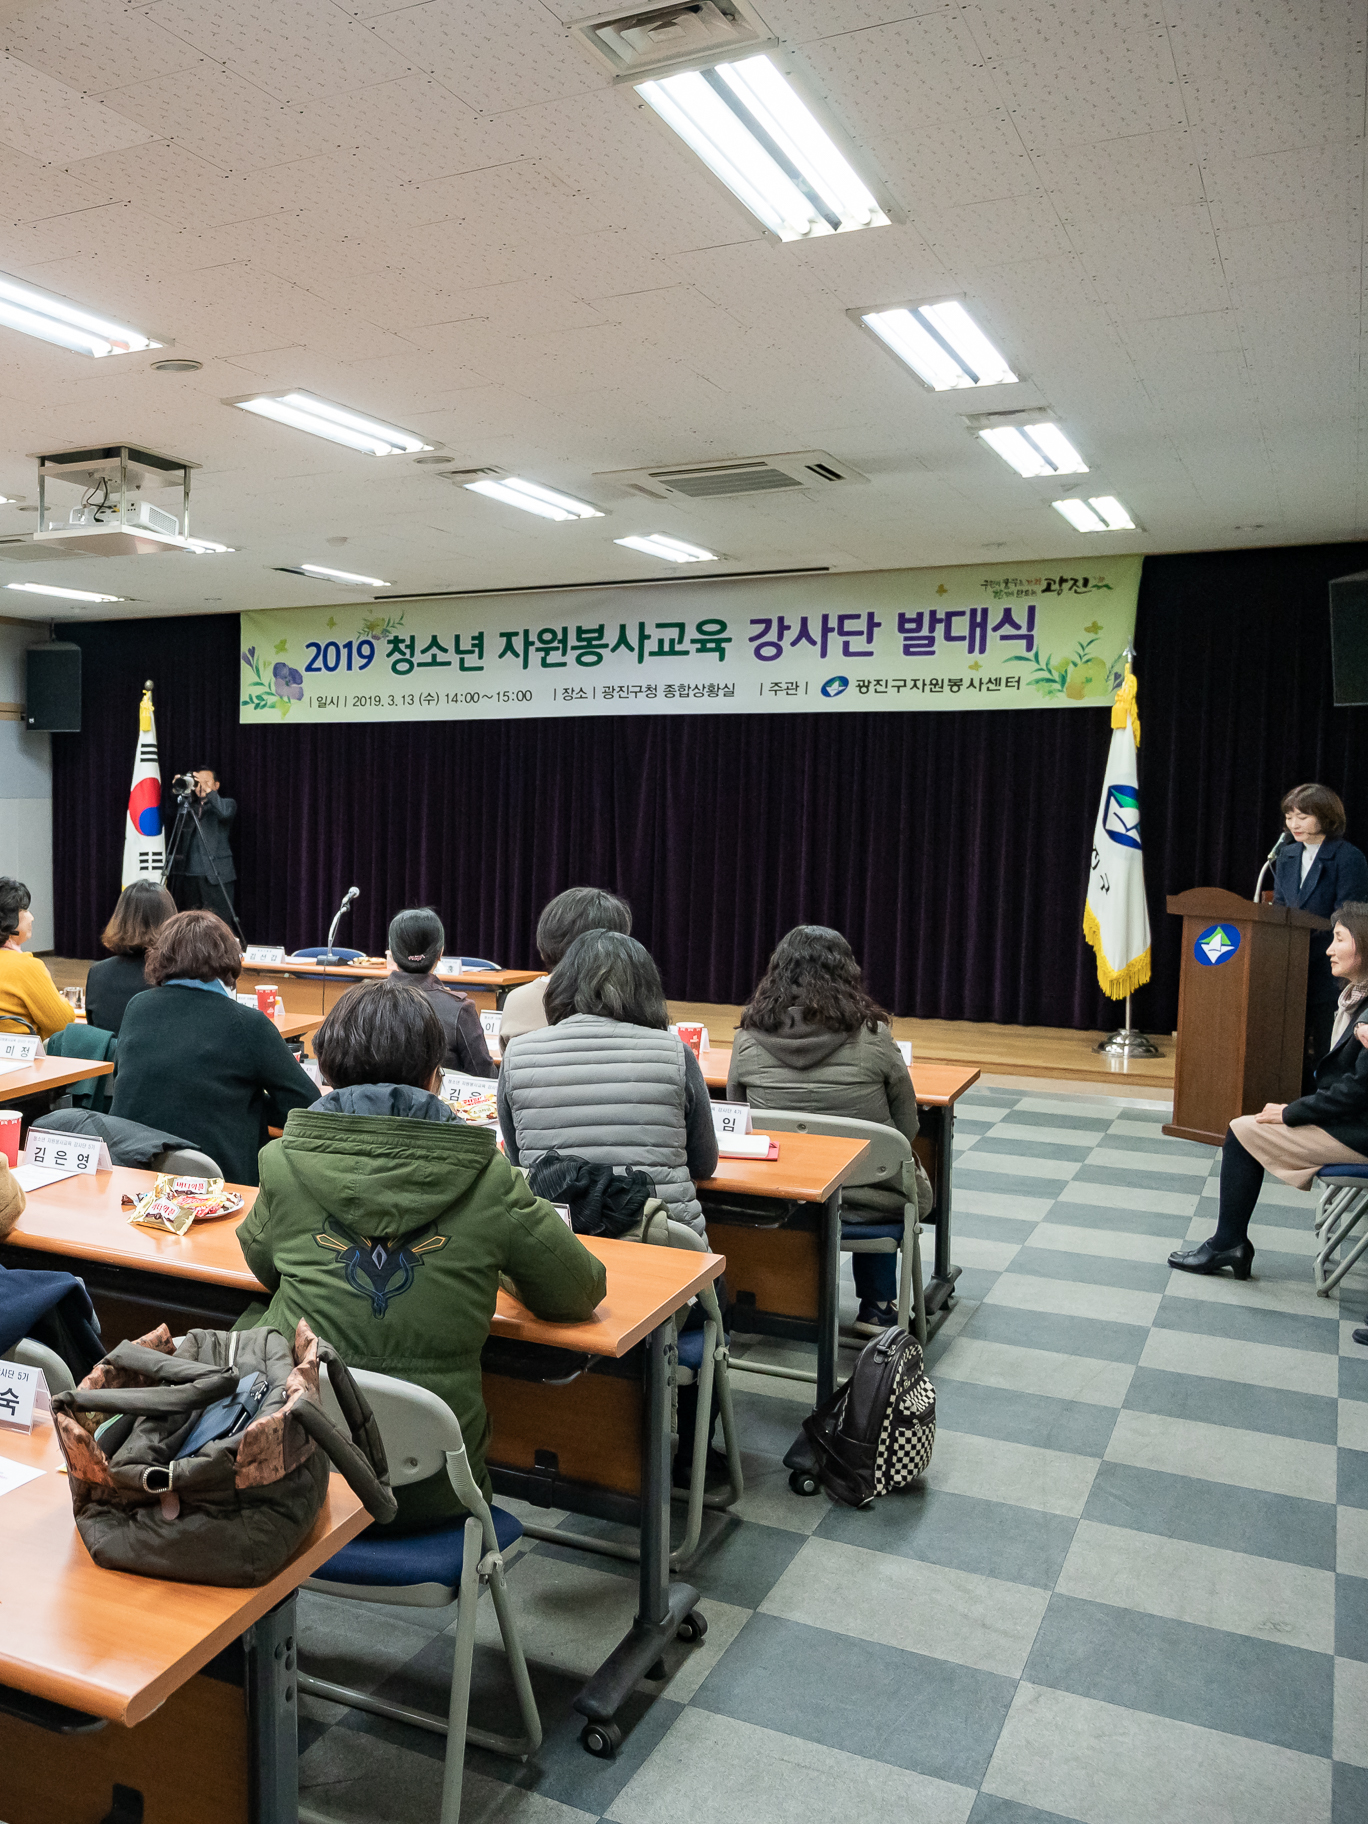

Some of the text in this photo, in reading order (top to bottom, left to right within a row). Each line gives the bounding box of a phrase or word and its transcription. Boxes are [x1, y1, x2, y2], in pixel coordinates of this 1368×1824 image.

[1041, 575, 1092, 596] 광진
[304, 604, 1037, 676] 2019 청소년 자원봉사교육 강사단 발대식
[561, 682, 736, 702] 장소 광진구청 종합상황실
[768, 676, 1022, 697] 주관 광진구자원봉사센터
[316, 695, 340, 709] 일시
[418, 691, 440, 707] (수)
[722, 1117, 736, 1133] 임
[34, 1146, 90, 1170] 김은영
[17, 1371, 30, 1382] 5기
